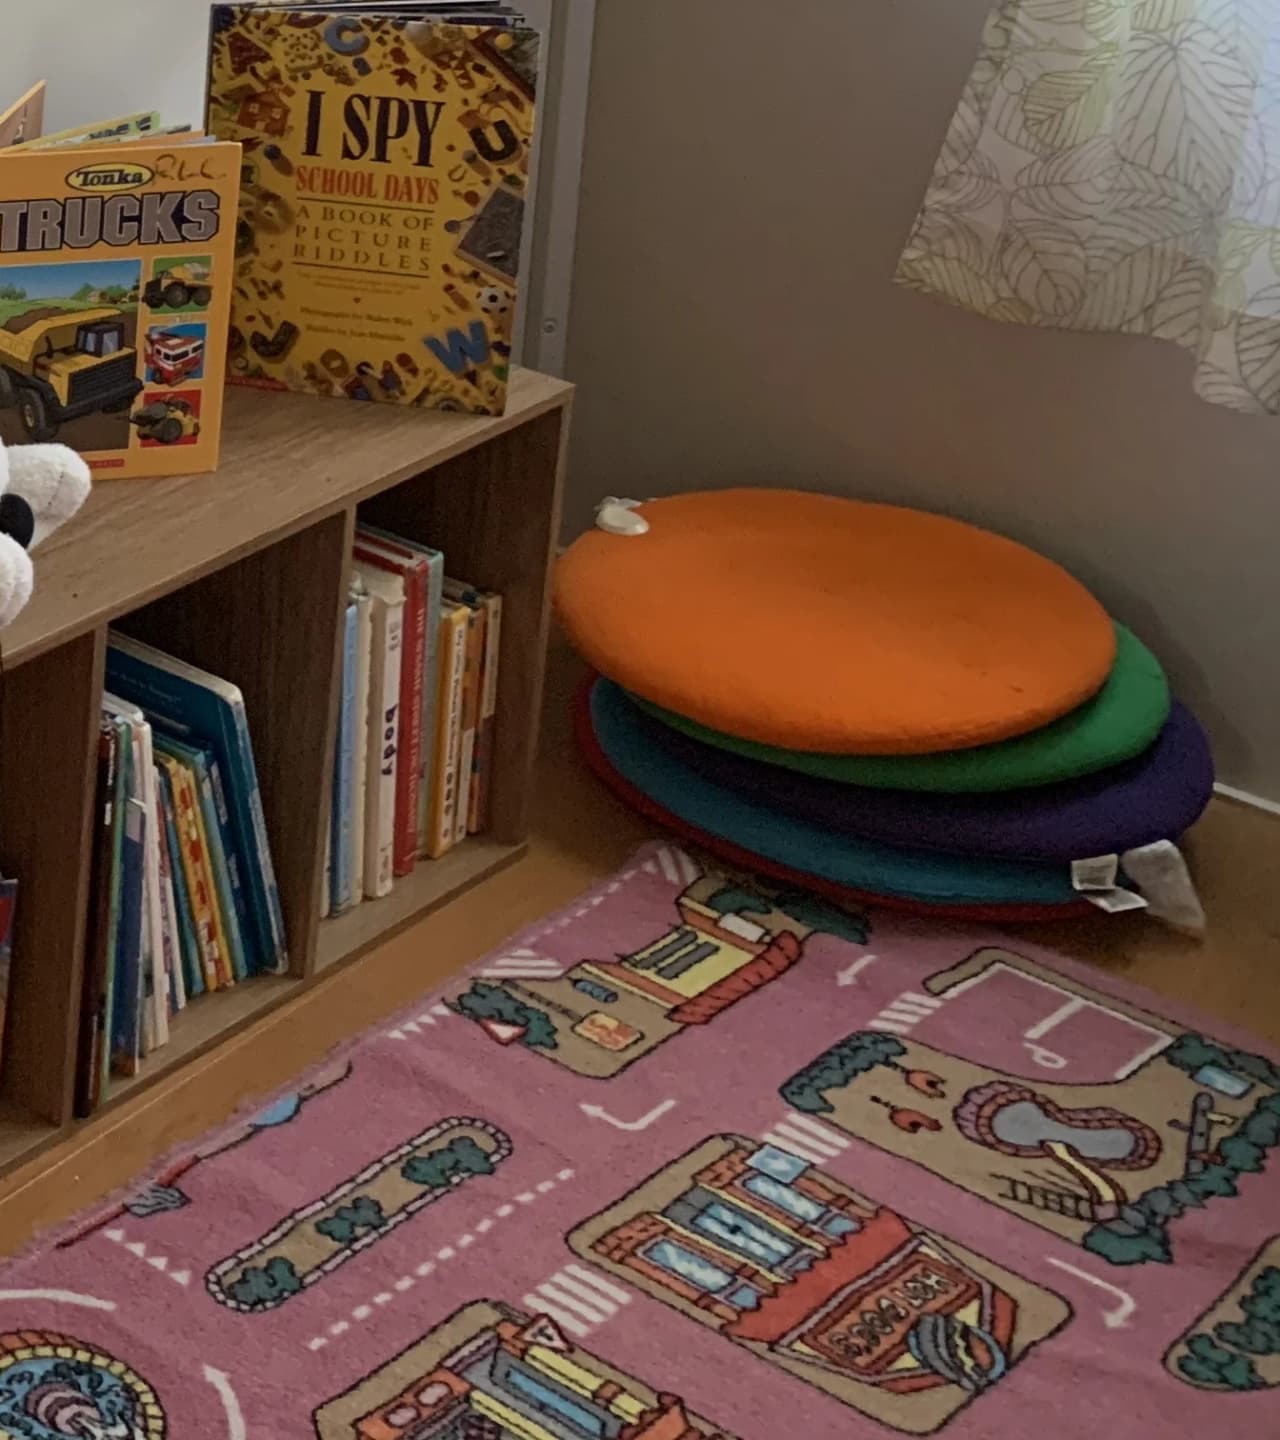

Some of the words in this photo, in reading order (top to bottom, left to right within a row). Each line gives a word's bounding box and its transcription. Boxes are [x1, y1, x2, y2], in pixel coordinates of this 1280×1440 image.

[302, 90, 326, 157] I
[341, 93, 447, 168] SPY
[75, 168, 144, 187] Tonka
[296, 165, 377, 198] SCHOOL
[384, 174, 440, 205] DAYS
[296, 205, 310, 220] A
[322, 206, 392, 227] BOOK
[403, 215, 434, 231] OF
[295, 224, 432, 252] PICTURE
[293, 243, 430, 272] RIDDLES
